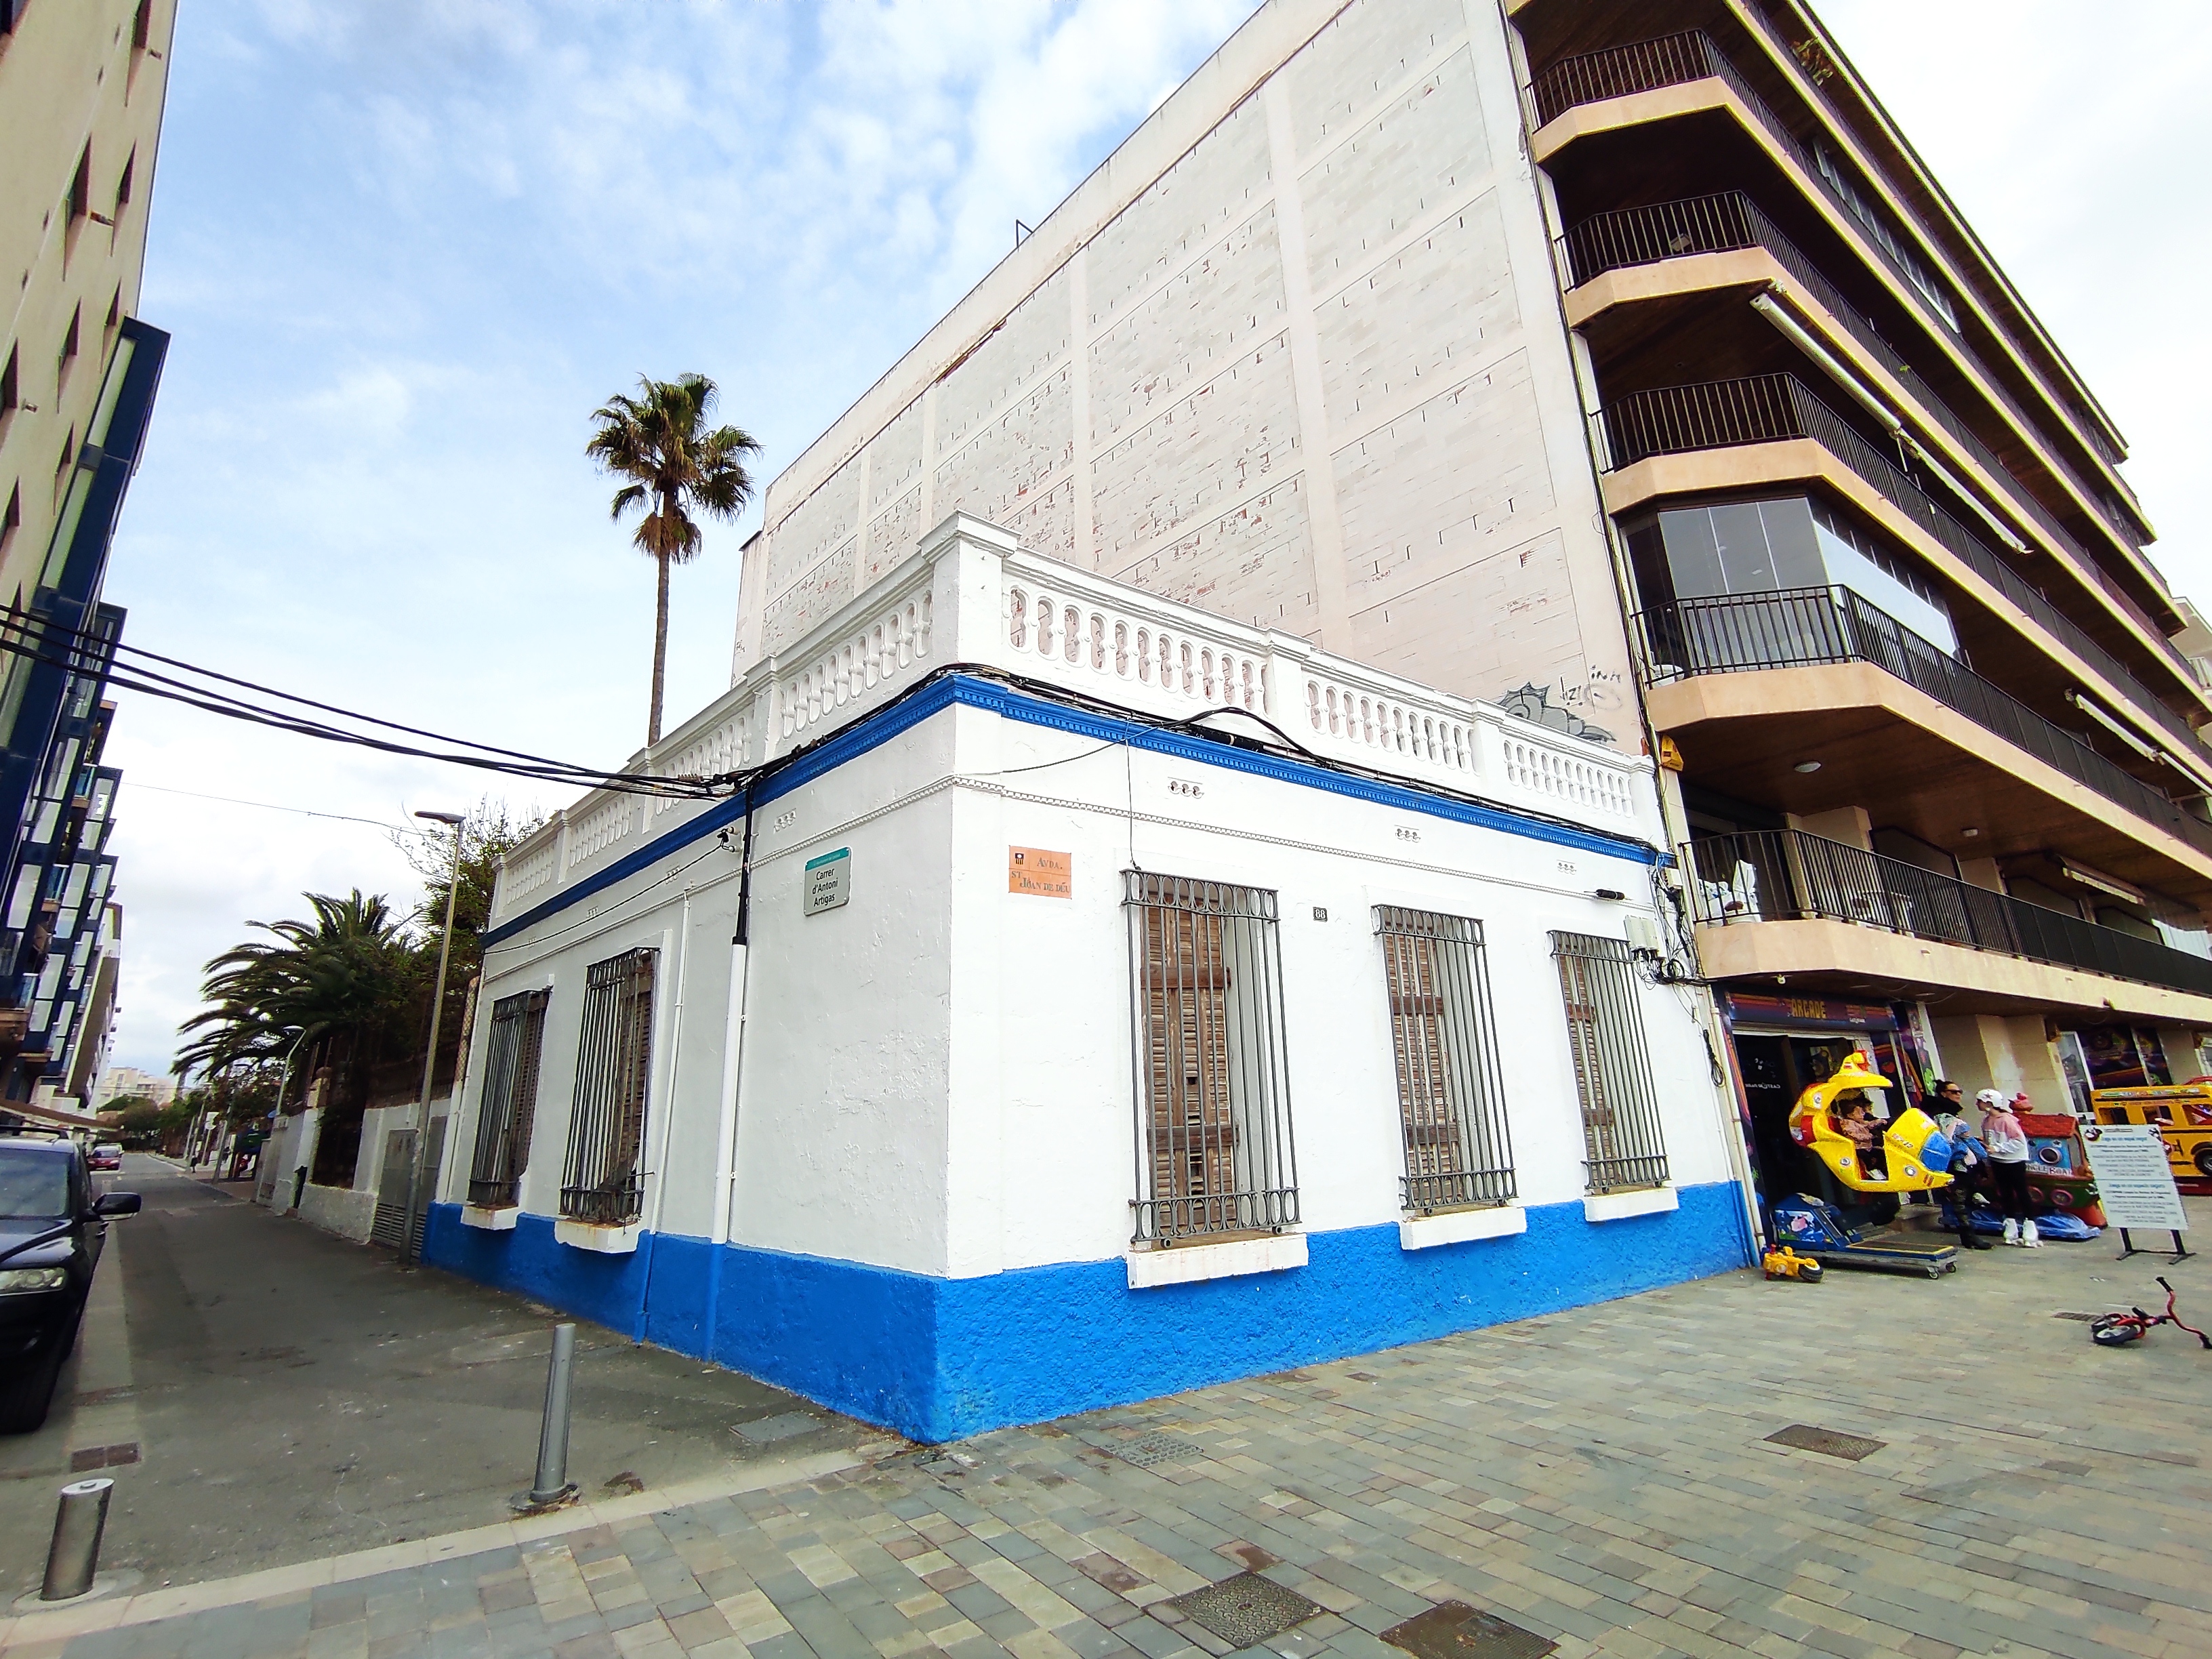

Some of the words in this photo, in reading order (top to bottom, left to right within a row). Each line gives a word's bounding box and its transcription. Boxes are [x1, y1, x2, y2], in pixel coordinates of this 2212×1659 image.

[816, 867, 835, 880] Carrer
[812, 878, 838, 894] d'Antoni
[1044, 883, 1054, 891] DE
[814, 893, 835, 907] Artigas
[1315, 909, 1326, 919] 88
[1791, 998, 1827, 1019] ARCADE
